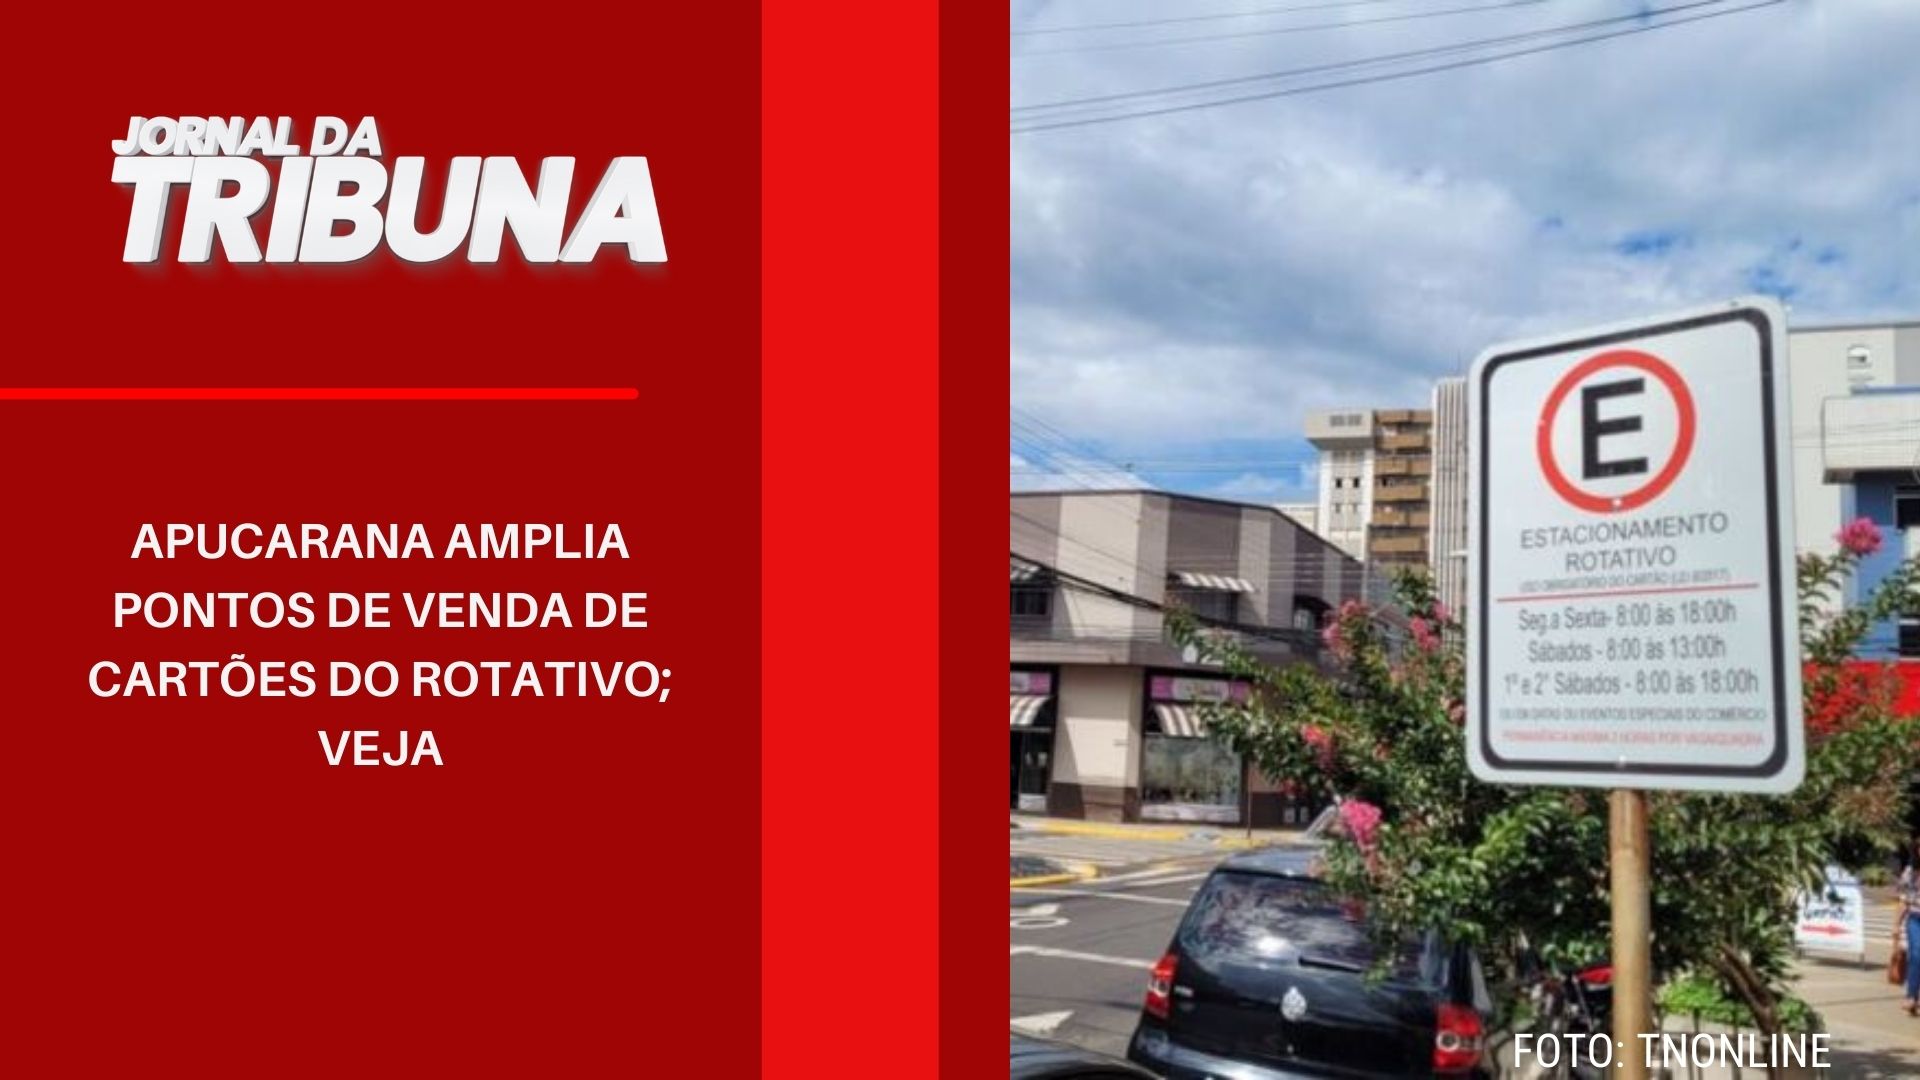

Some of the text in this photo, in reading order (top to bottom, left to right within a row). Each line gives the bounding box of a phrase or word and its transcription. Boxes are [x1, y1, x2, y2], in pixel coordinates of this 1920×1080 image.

[1581, 377, 1648, 479] E
[1520, 512, 1728, 549] ESTACIONAMENTO
[1564, 546, 1677, 573] ROTATIVO
[1616, 602, 1651, 627] 8:00
[1681, 597, 1737, 624] 18:00h
[1528, 637, 1592, 663] Sábados
[1606, 636, 1640, 661] 8:00
[1671, 632, 1726, 660] 13:00h
[1521, 677, 1531, 696] e
[1554, 669, 1620, 696] Sábados
[1636, 668, 1671, 695] 8:00
[1701, 665, 1759, 694] 18:00h
